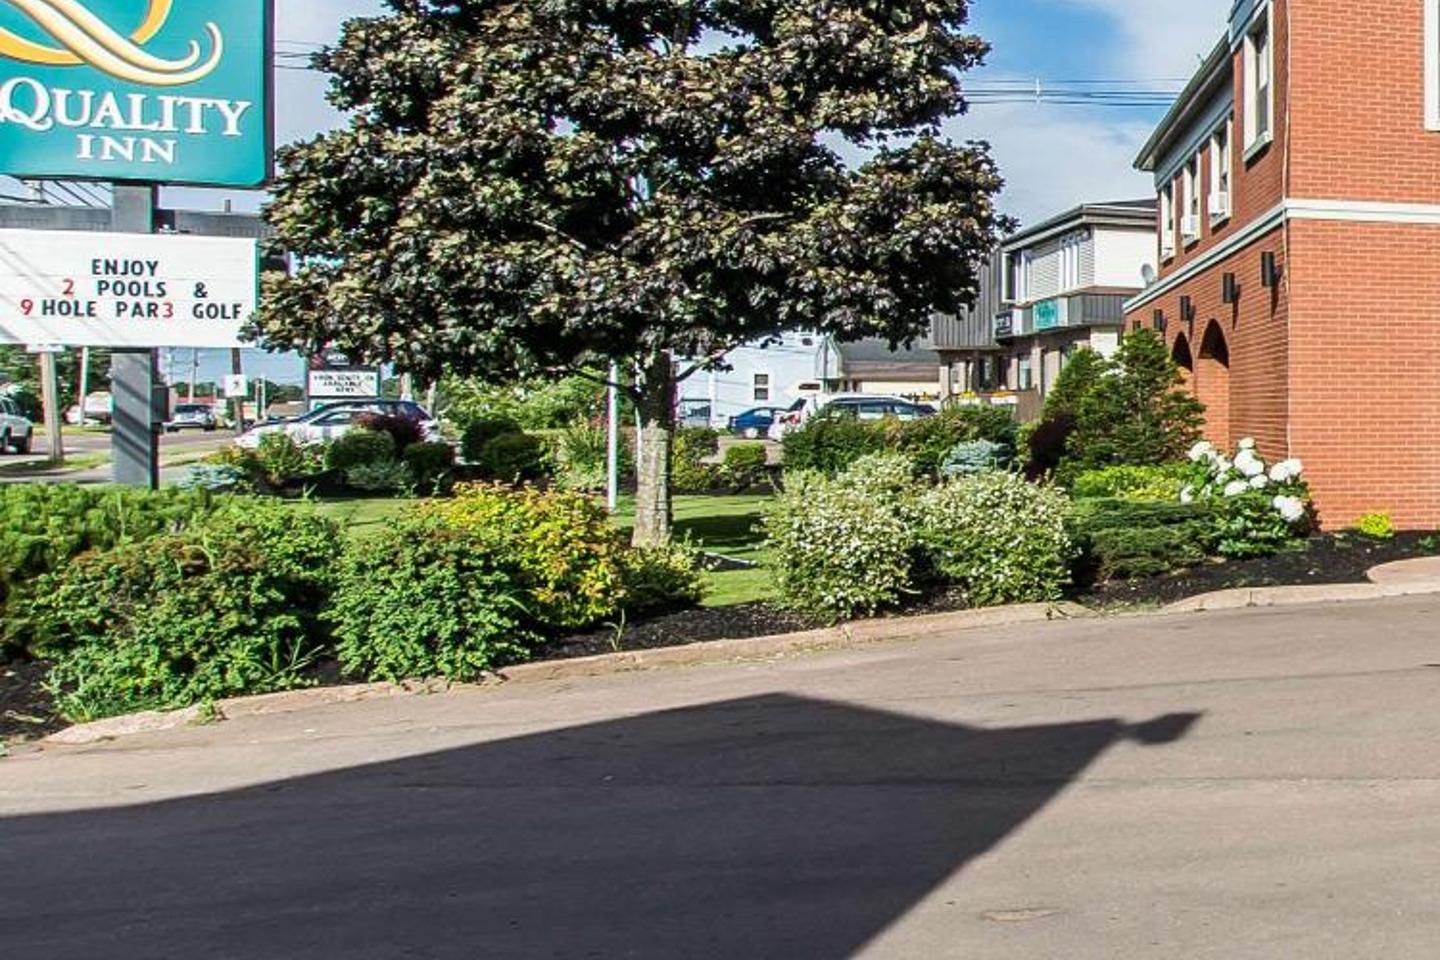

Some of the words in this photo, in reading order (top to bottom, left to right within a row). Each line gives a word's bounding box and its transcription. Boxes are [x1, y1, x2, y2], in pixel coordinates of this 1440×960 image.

[0, 77, 252, 136] QUALITY
[75, 134, 177, 164] INN
[91, 258, 159, 277] ENJOY
[61, 278, 75, 296] 2
[97, 279, 167, 298] POOLS
[193, 281, 208, 298] &
[20, 298, 34, 316] 9
[41, 299, 97, 317] HOLE
[192, 302, 242, 320] GOLF
